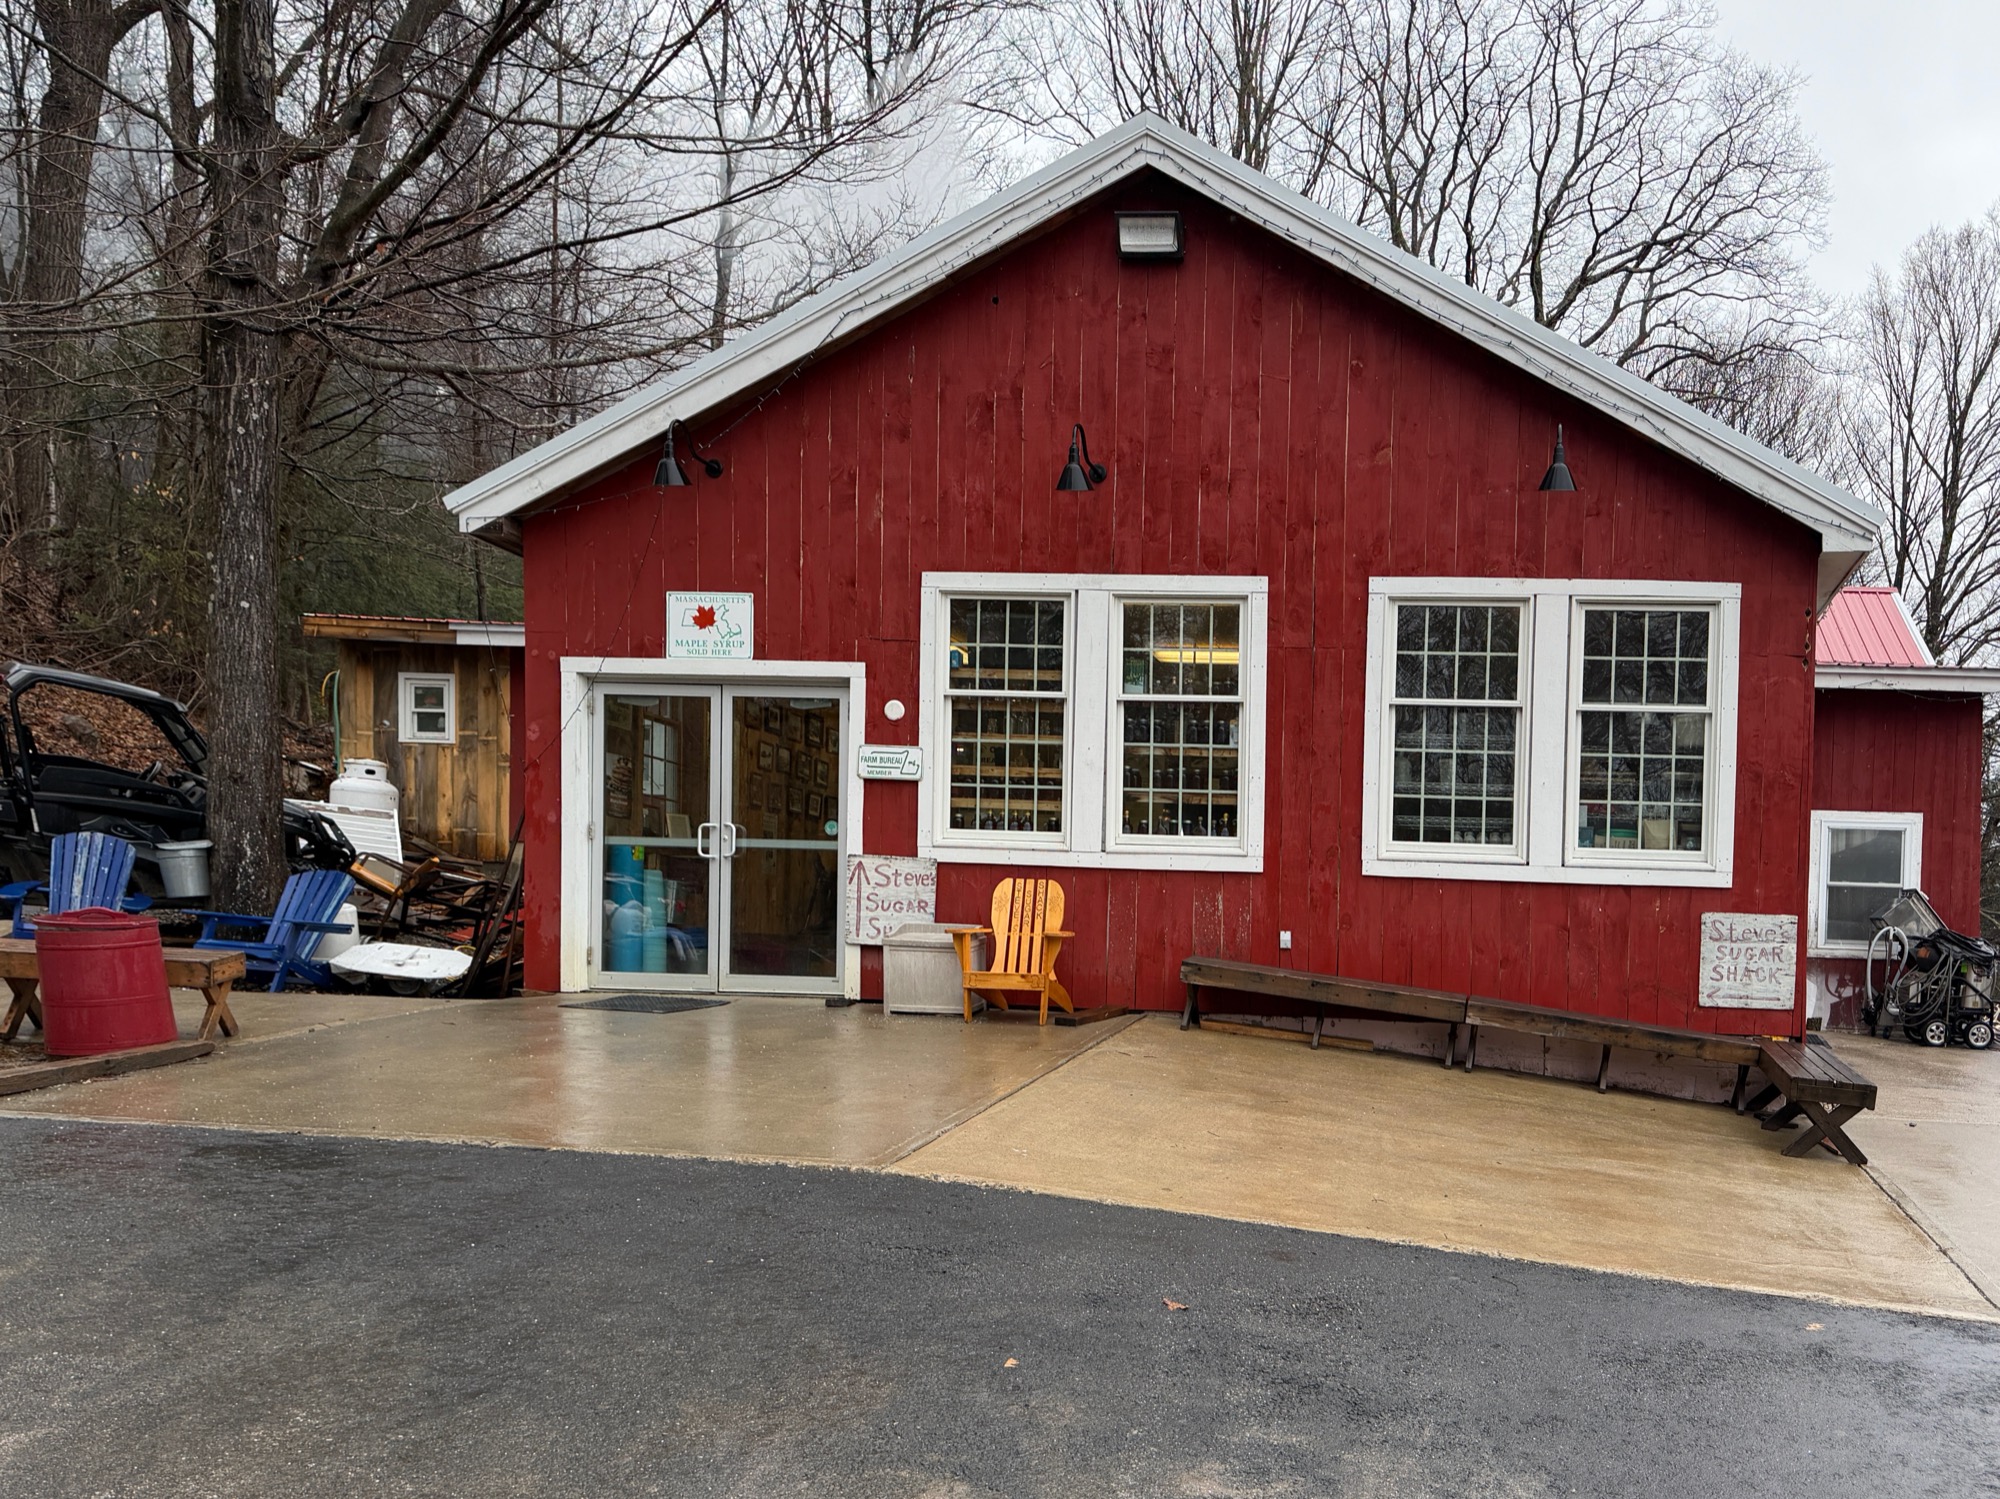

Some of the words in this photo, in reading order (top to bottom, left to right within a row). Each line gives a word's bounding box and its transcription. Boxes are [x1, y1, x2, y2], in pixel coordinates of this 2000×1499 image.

[675, 596, 746, 604] MASSACHUSETTS
[675, 639, 708, 648] MAPLE
[713, 640, 745, 648] SYRUP
[860, 756, 878, 764] FARM
[879, 756, 903, 765] BUREAU
[865, 892, 929, 914] SUGAR
[1716, 944, 1785, 963] SUGAR
[1709, 964, 1782, 985] SHACK
